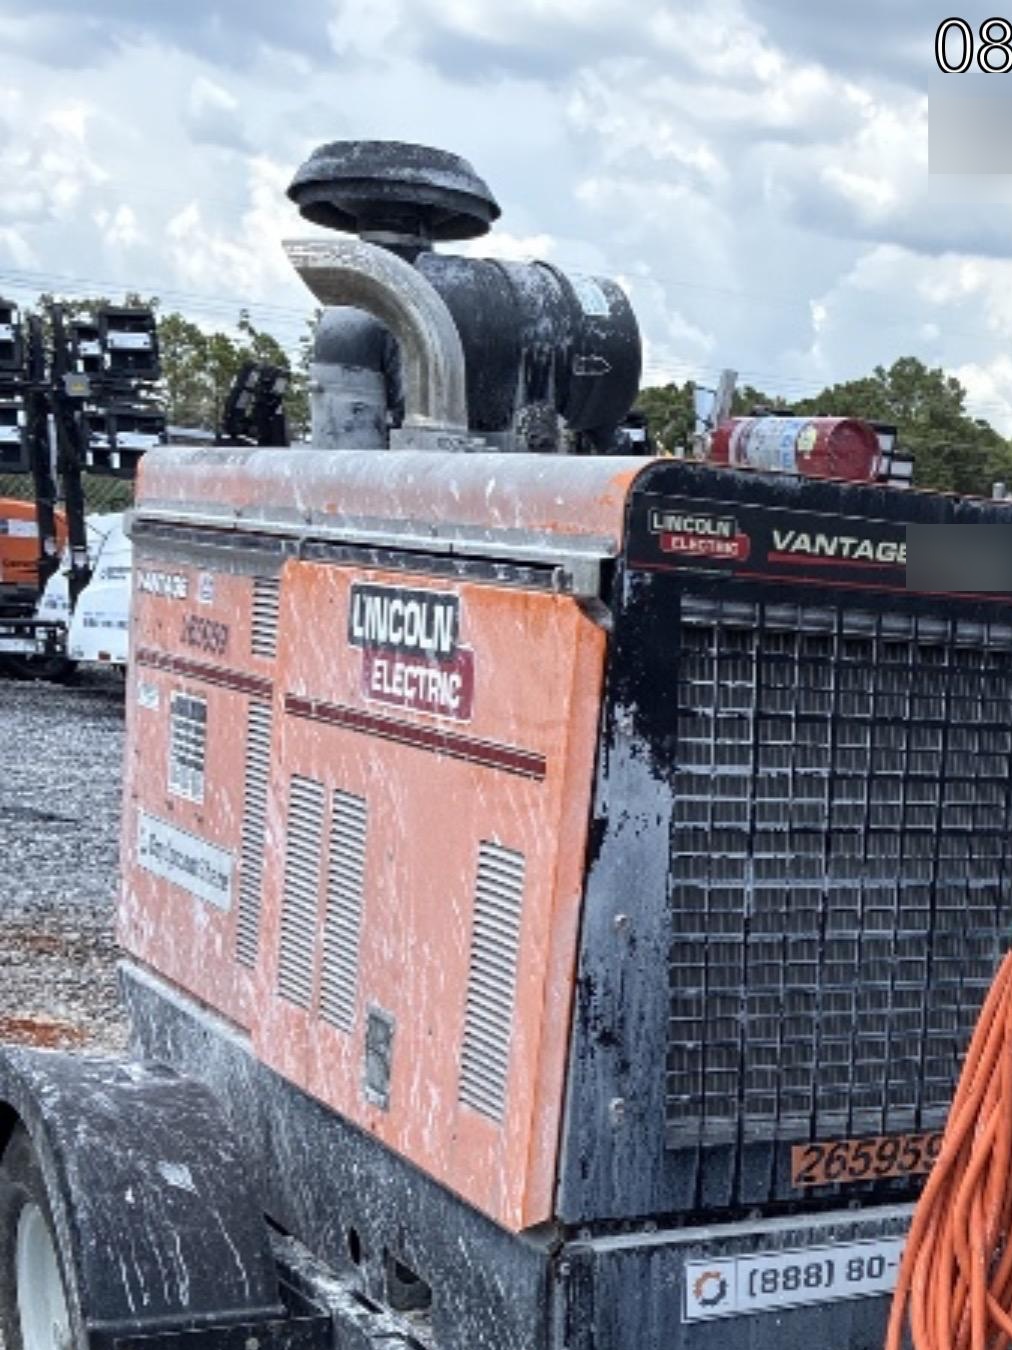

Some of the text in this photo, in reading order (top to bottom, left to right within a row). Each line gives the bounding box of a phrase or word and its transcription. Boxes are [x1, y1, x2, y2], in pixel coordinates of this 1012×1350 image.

[652, 511, 732, 538] LINCOLN
[670, 535, 740, 556] ELECTRIC
[352, 592, 454, 653] LINCOLN
[370, 658, 463, 709] ELECTRIC
[795, 1133, 943, 1183] 265959
[748, 1251, 905, 1297] (888) 80-
